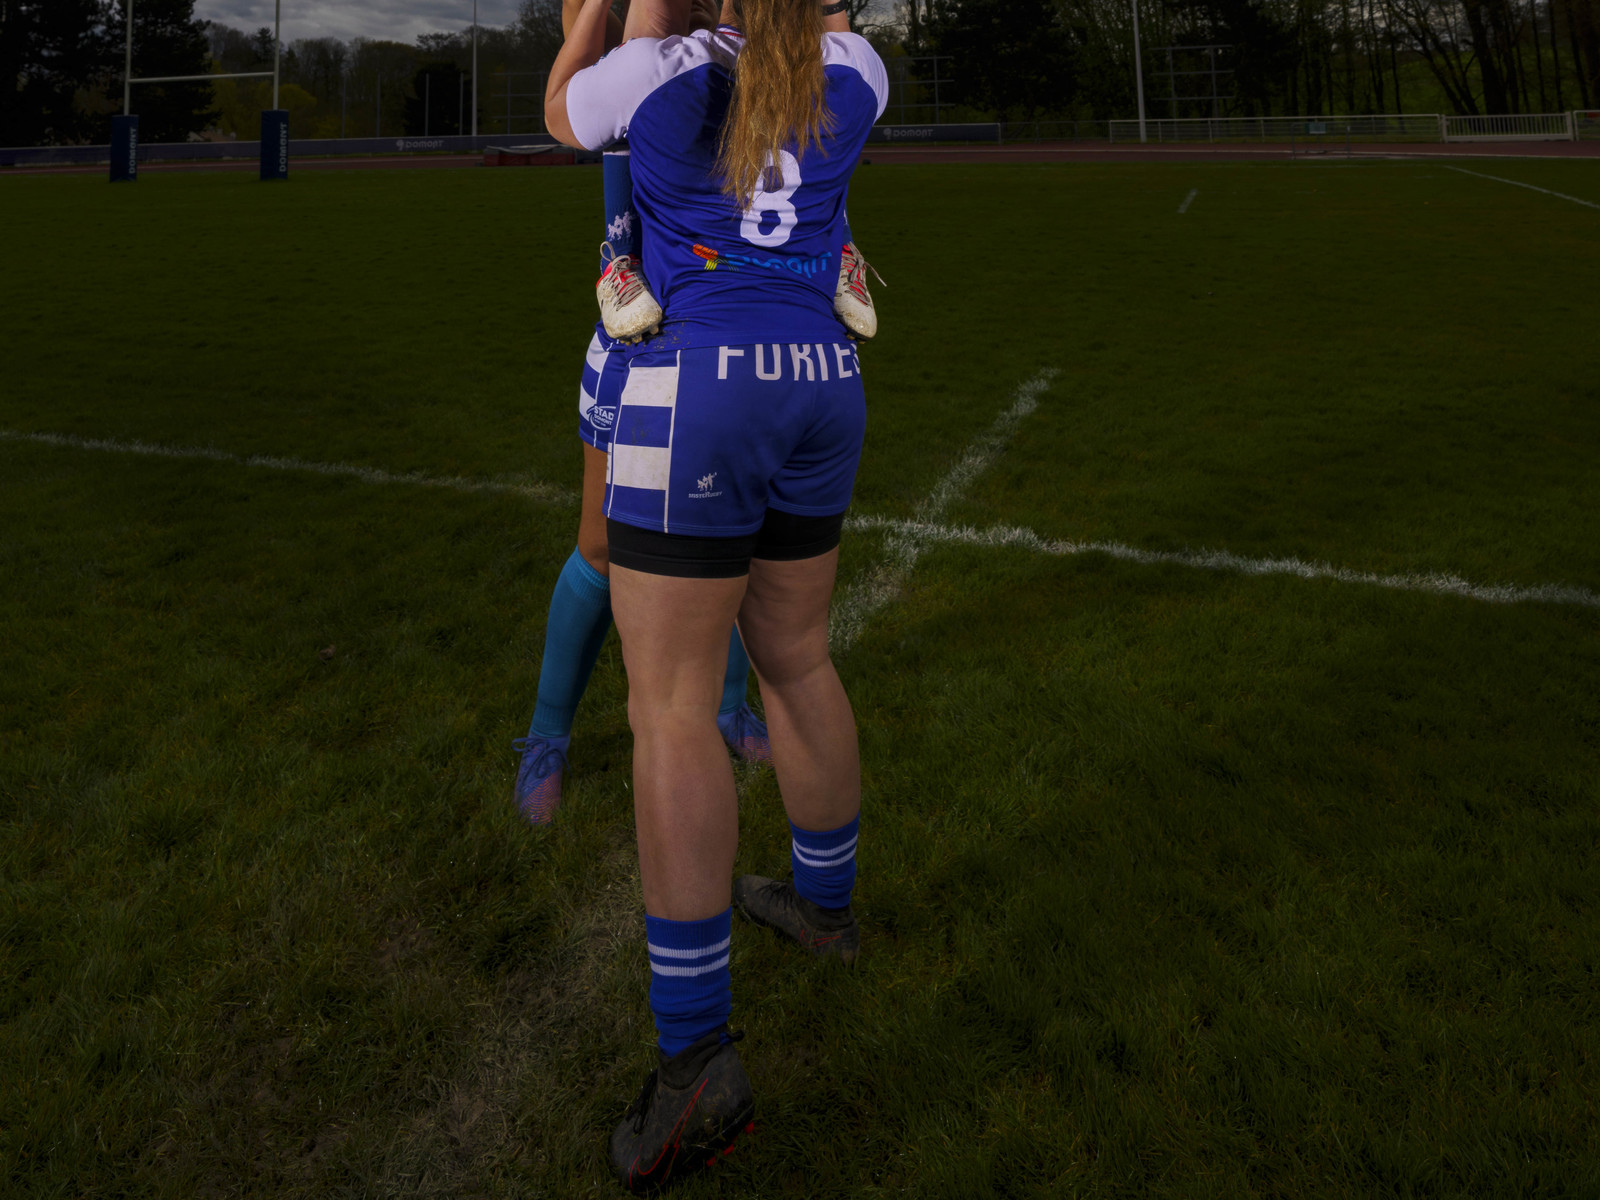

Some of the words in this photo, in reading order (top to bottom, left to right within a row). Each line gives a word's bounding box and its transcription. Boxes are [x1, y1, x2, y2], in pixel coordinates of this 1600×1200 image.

[278, 121, 288, 173] DOMONT
[405, 139, 445, 149] DOMONT
[893, 128, 934, 138] DOMONT
[128, 127, 137, 175] DOMONT
[740, 149, 802, 248] 8
[594, 405, 615, 421] STAD
